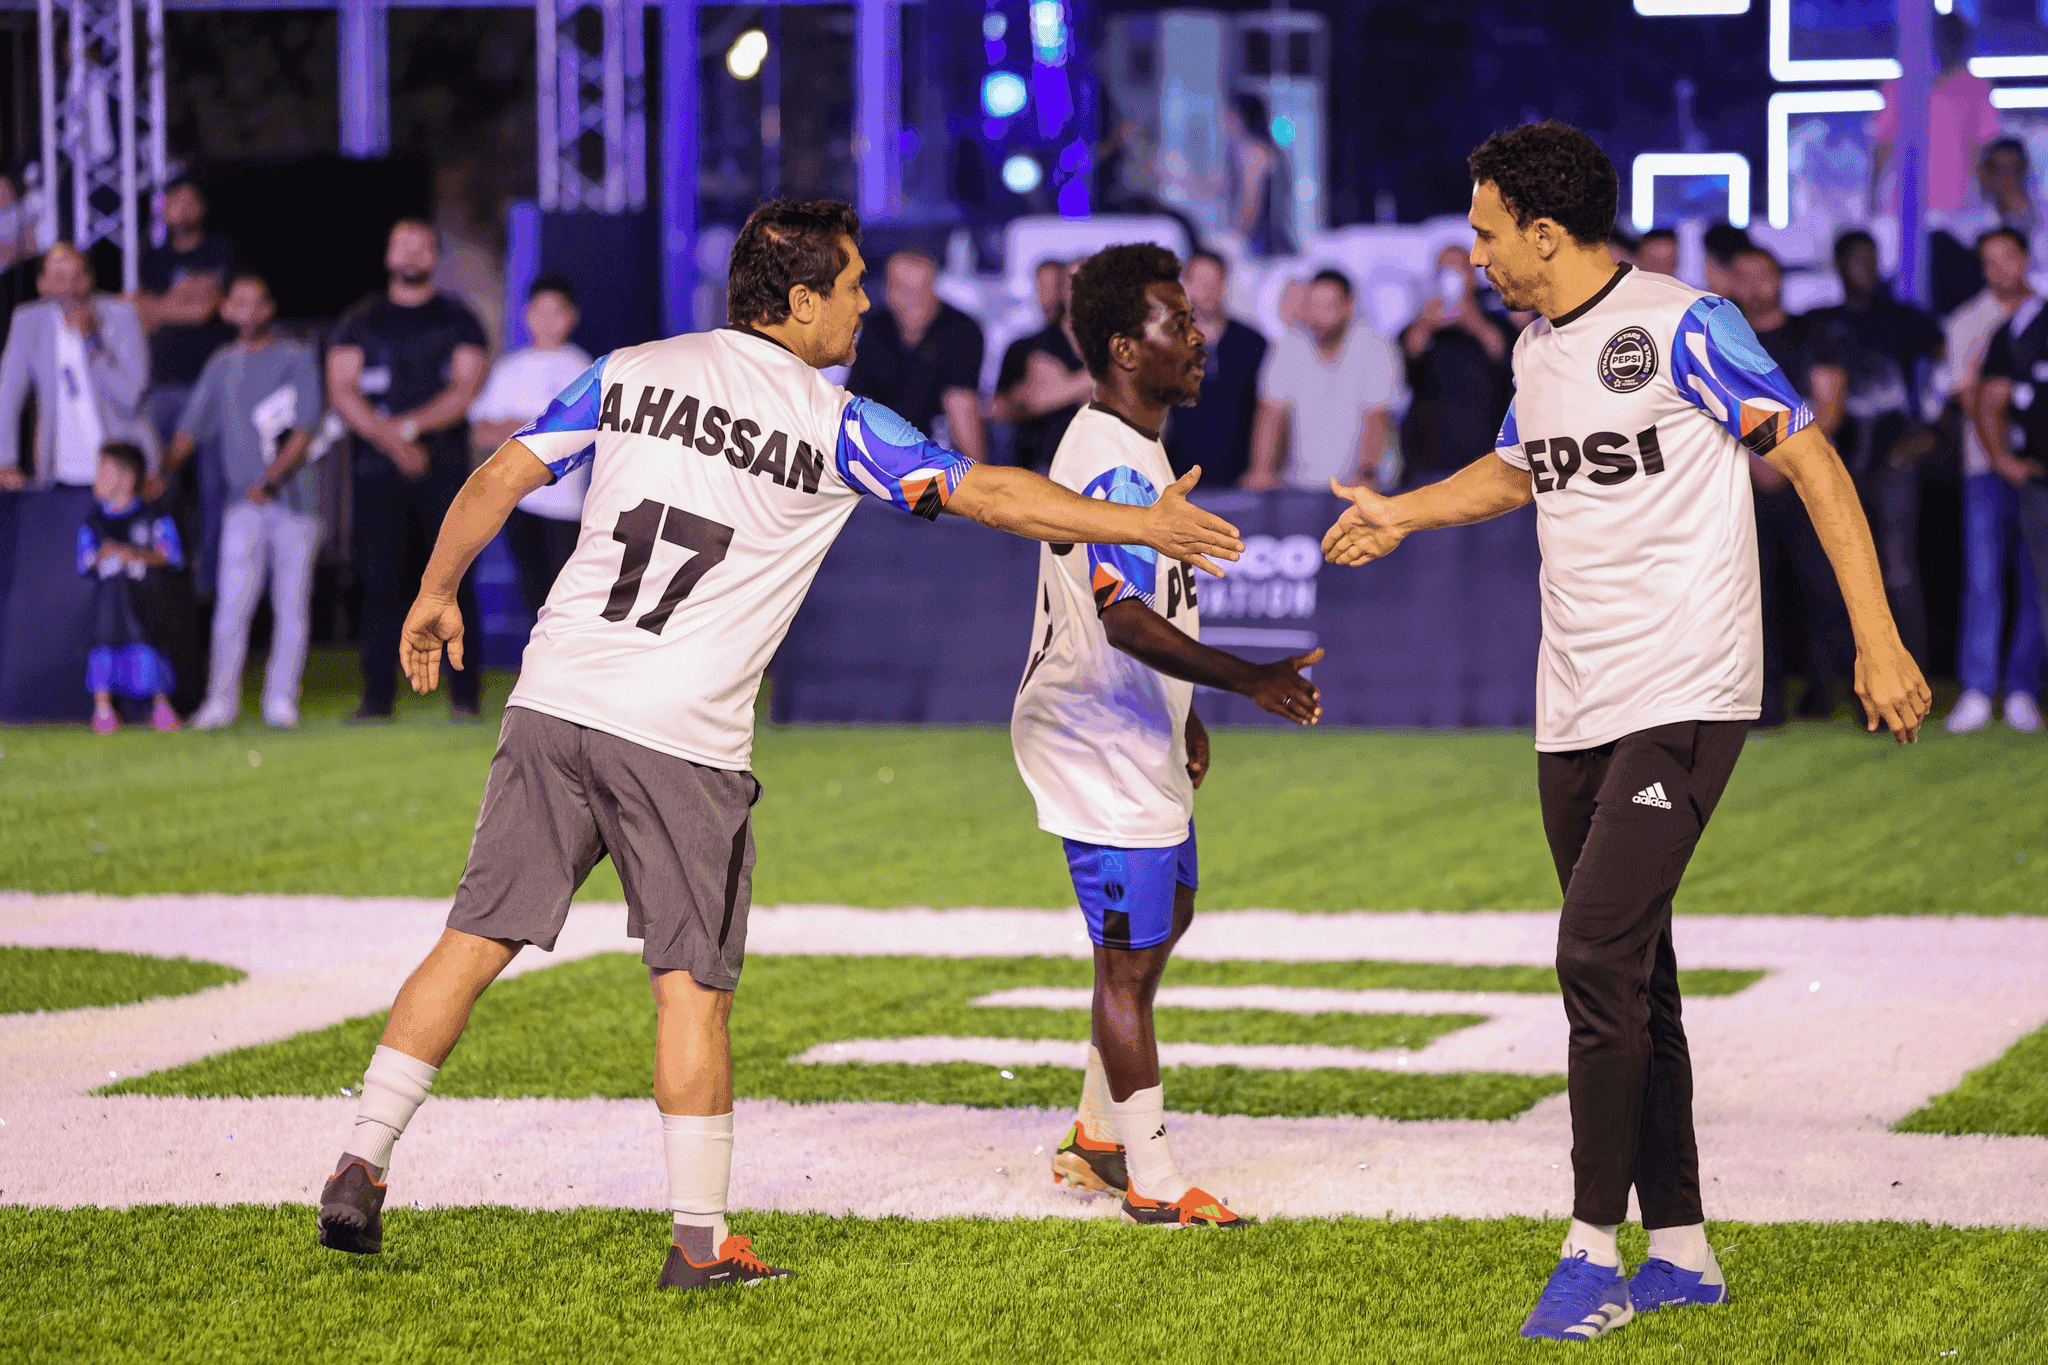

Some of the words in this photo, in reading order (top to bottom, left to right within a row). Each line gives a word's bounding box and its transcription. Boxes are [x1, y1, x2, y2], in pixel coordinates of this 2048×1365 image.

[1617, 332, 1641, 342] STARS
[1602, 347, 1613, 376] STARS
[1612, 355, 1641, 364] PEPSI
[1643, 343, 1652, 373] STARS
[597, 383, 824, 494] A.HASSAN
[1524, 424, 1665, 494] EPSI
[599, 498, 735, 636] 17
[1632, 795, 1672, 810] adidas
